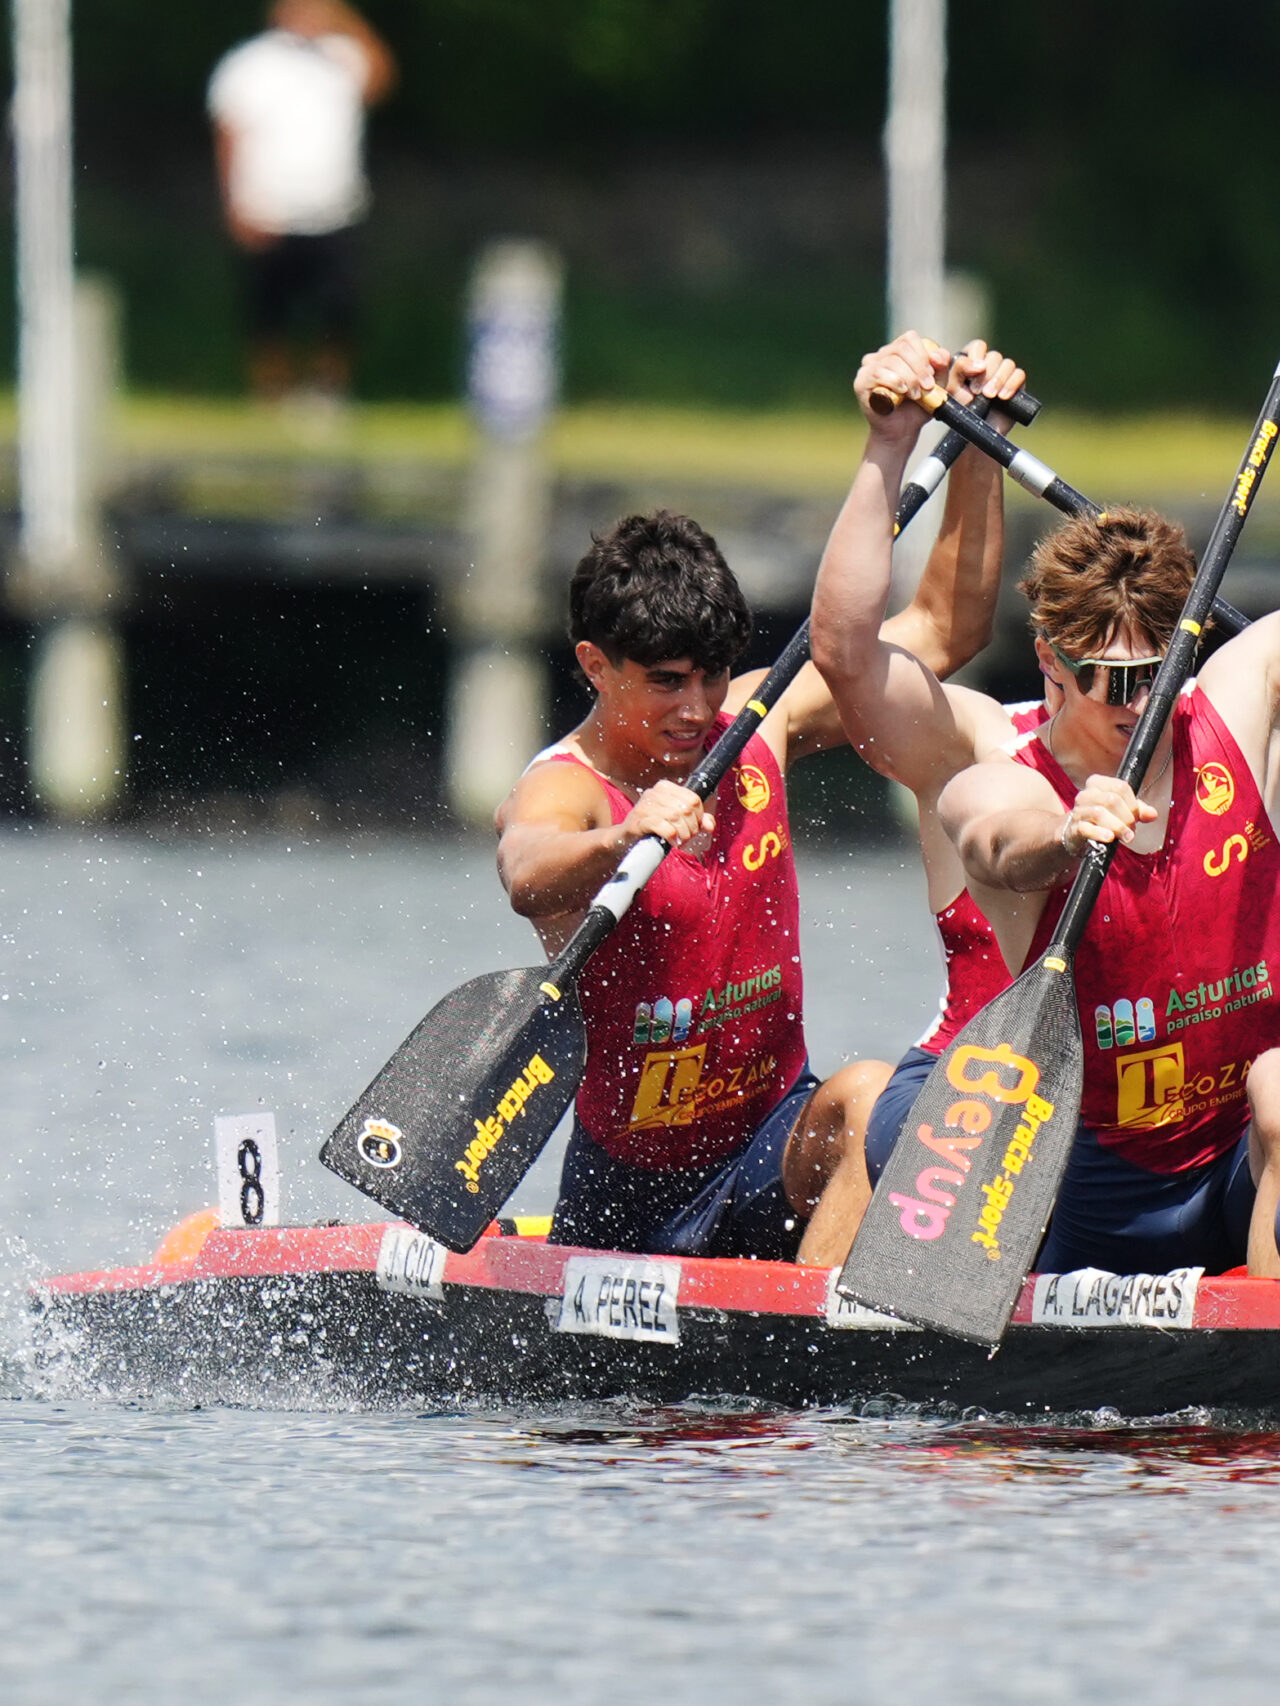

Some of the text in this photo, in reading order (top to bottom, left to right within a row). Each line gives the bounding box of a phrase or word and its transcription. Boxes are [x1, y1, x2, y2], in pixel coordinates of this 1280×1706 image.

[700, 964, 782, 1016] Asturias
[1164, 959, 1269, 1017] Asturias
[1166, 981, 1273, 1035] paraíso natural
[1169, 1101, 1207, 1120] GRUPO
[237, 1138, 265, 1225] 8
[596, 1275, 667, 1332] PEREZ
[1042, 1271, 1188, 1319] A. LAGARES
